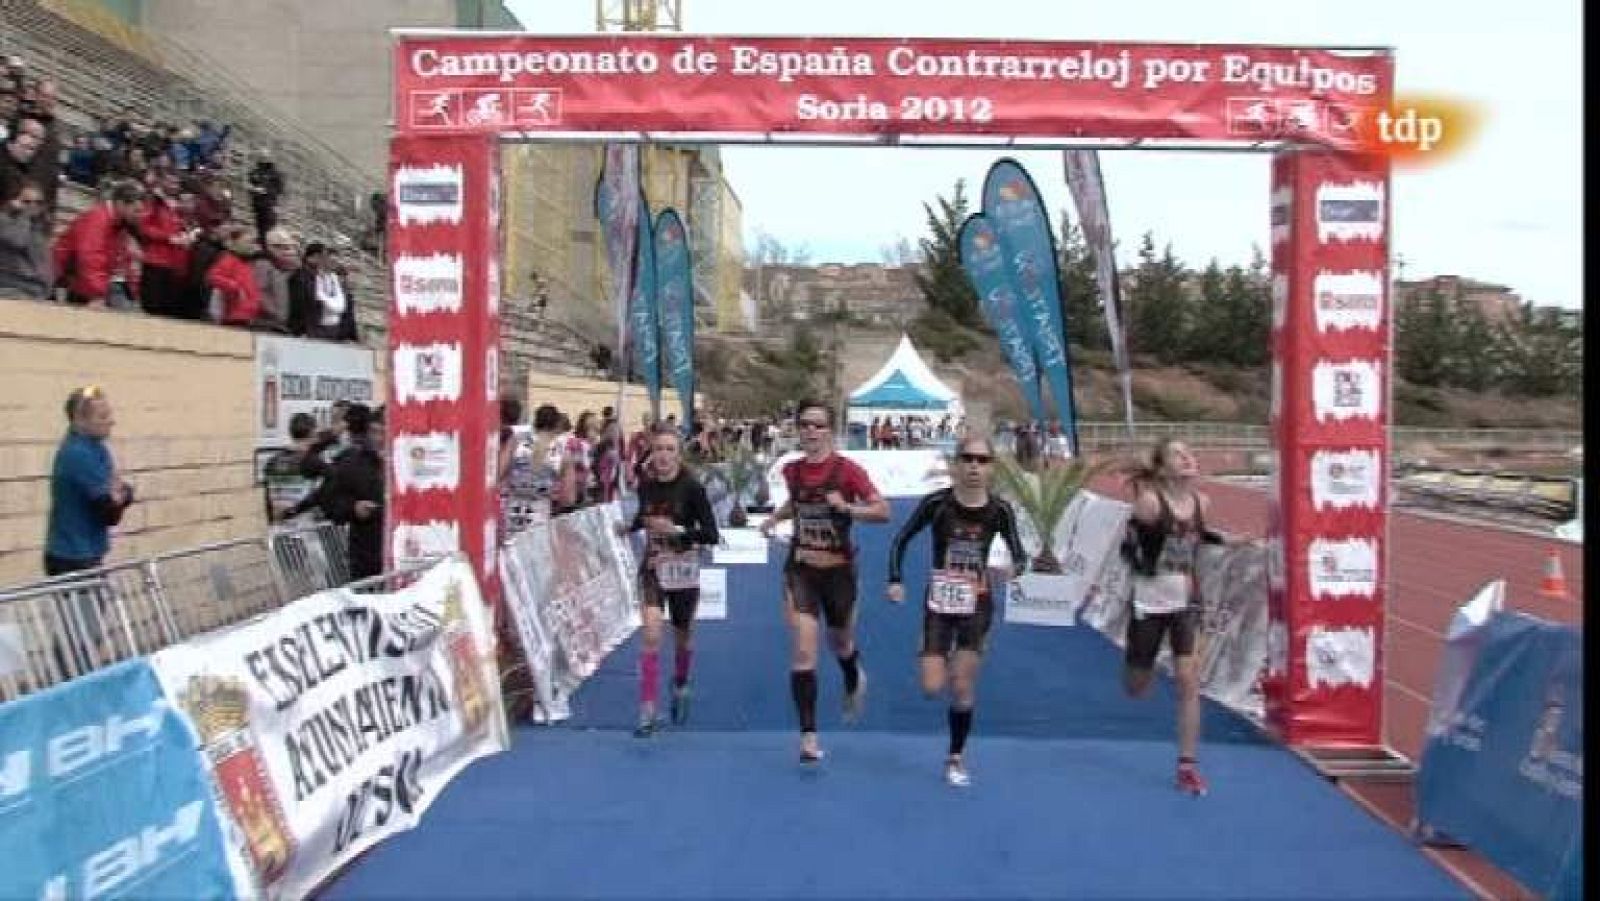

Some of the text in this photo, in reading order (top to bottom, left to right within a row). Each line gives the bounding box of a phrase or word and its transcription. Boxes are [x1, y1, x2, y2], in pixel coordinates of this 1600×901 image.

[411, 46, 1377, 96] Campeonato de España Contrarreloj por Equipos
[797, 94, 993, 122] Soria 2012
[48, 698, 166, 778] BH
[83, 800, 204, 901] BH
